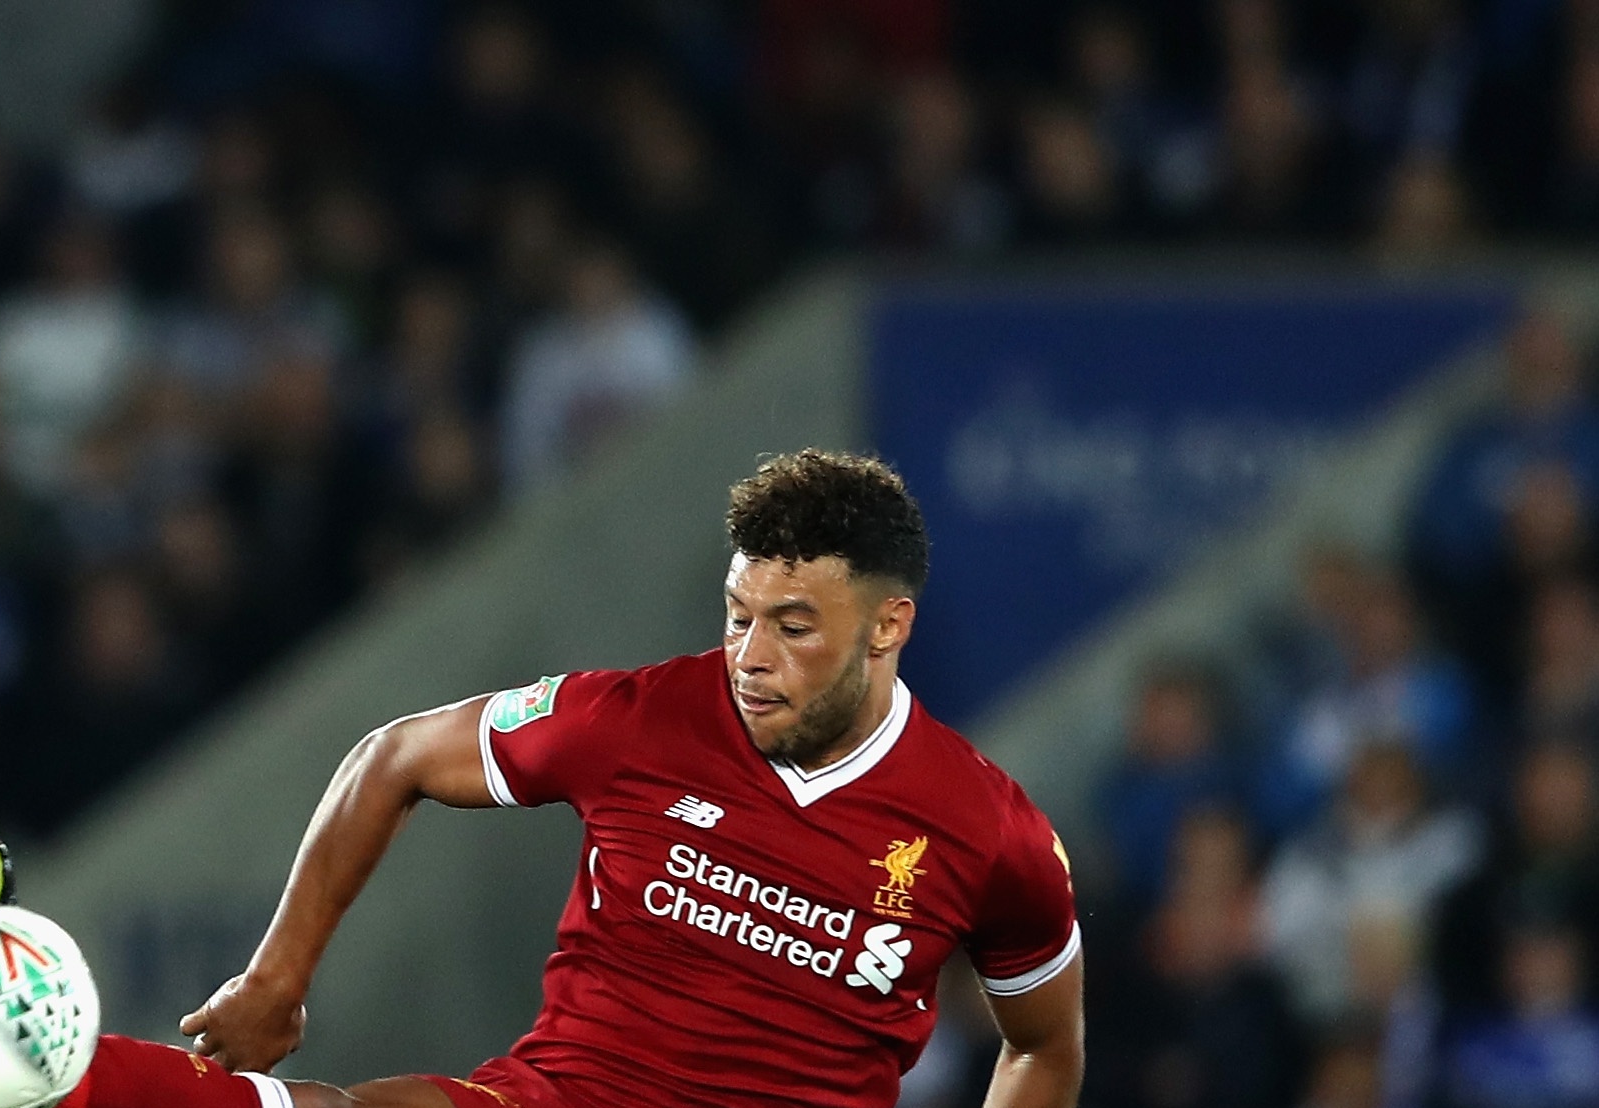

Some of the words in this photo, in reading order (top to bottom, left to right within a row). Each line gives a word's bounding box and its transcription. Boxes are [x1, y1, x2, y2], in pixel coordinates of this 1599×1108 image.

[643, 880, 844, 978] Chartered
[665, 844, 855, 940] Standard
[873, 891, 913, 910] LFC
